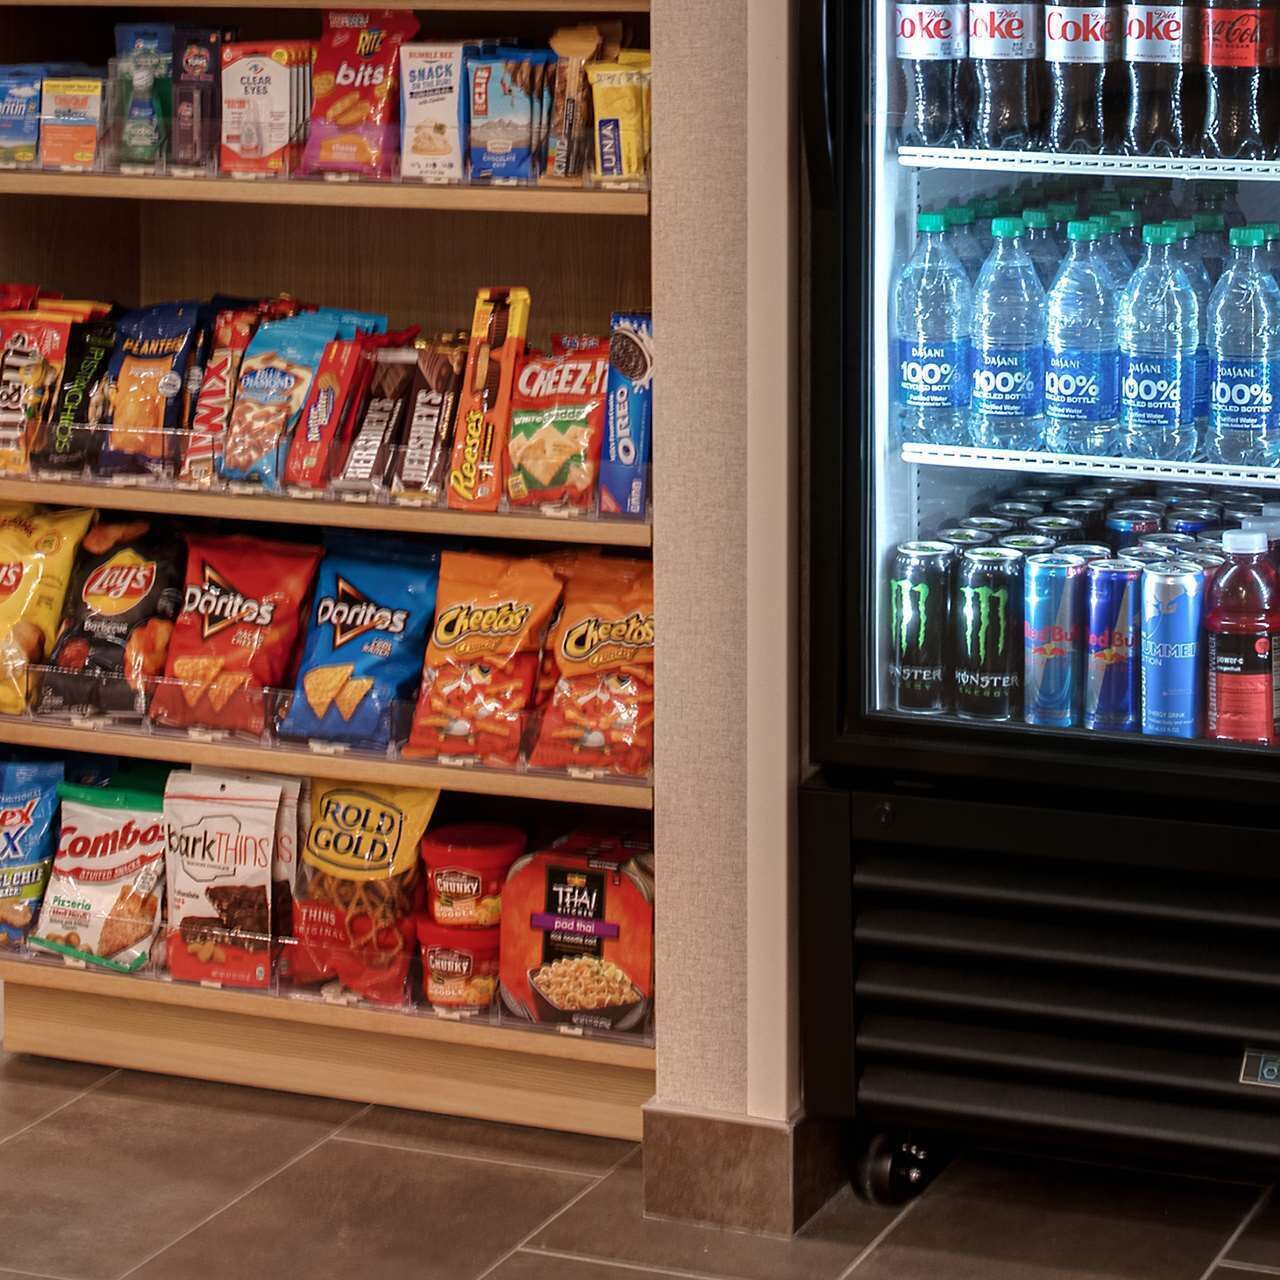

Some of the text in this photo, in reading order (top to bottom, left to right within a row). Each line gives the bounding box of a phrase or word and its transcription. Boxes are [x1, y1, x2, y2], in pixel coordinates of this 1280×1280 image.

[896, 7, 953, 39] Coke
[1047, 11, 1113, 42] Coke
[356, 30, 387, 55] RITZ
[240, 75, 272, 86] CLEAR
[335, 63, 385, 88] bits
[408, 65, 453, 84] SNACK
[243, 85, 269, 96] EYES
[603, 124, 618, 177] LUNA
[241, 374, 296, 391] DIAMOND
[973, 370, 1034, 394] 100%
[1045, 371, 1099, 397] 100%
[1122, 376, 1181, 402] 100%
[1211, 382, 1273, 405] 100%
[56, 346, 105, 454] PISTACHIOS
[343, 396, 395, 480] HERSHEY'S
[402, 388, 444, 482] HERSHEY'S
[617, 387, 637, 466] OREO
[450, 409, 484, 500] Reese's
[86, 560, 156, 599] Lay's
[184, 583, 275, 627] Doritos
[317, 596, 410, 635] Doritos
[83, 621, 129, 636] Barbecue
[432, 601, 531, 649] Cheetos
[454, 639, 500, 655] Crunchy
[561, 614, 655, 663] Cheetos
[588, 649, 639, 667] Crunchy
[1207, 632, 1217, 732] vitaminwater
[323, 797, 395, 836] ROLD
[169, 823, 270, 869] barkTHINS
[313, 827, 390, 863] GOLD
[436, 878, 480, 895] CHUNKY
[552, 884, 597, 910] THAI
[52, 894, 93, 911] Pizzeria
[557, 907, 594, 918] KITCHEN
[301, 907, 337, 926] THINS
[554, 919, 596, 933] pad thai
[428, 956, 470, 974] CHUNKY
